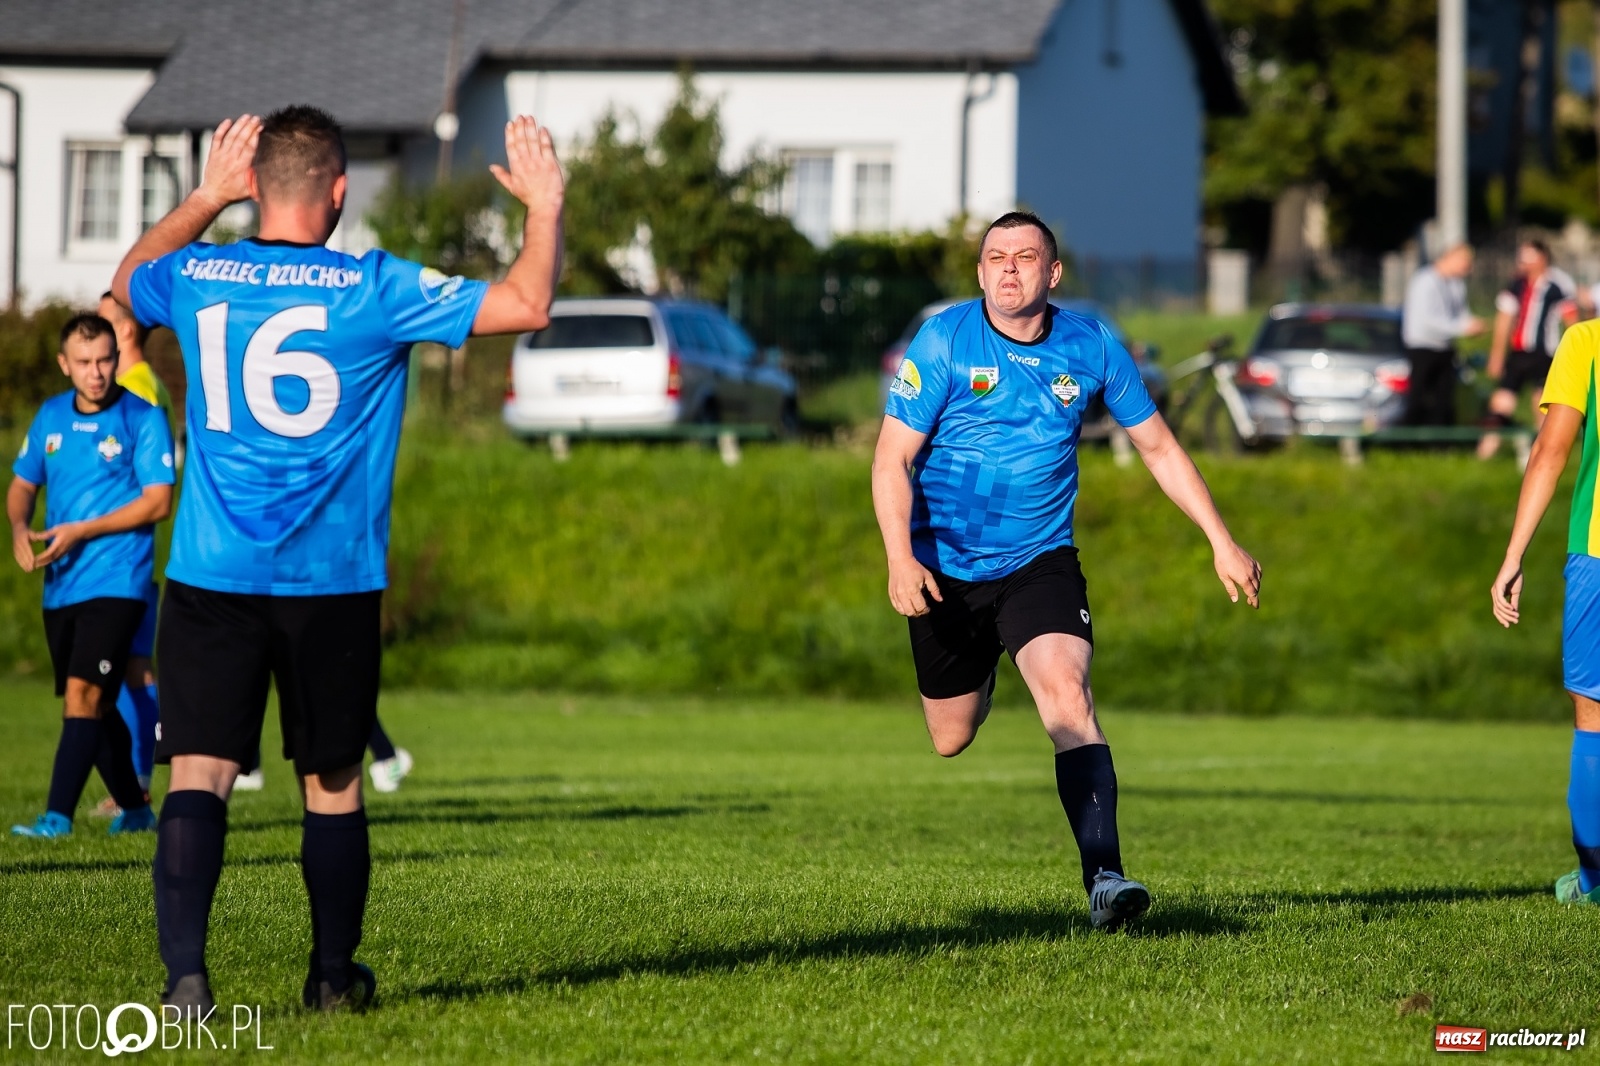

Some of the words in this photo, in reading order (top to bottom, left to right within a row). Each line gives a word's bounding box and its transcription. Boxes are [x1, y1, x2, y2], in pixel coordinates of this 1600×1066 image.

[181, 258, 265, 285] STRZELEC
[195, 300, 341, 438] 16
[1015, 354, 1040, 367] VIGO
